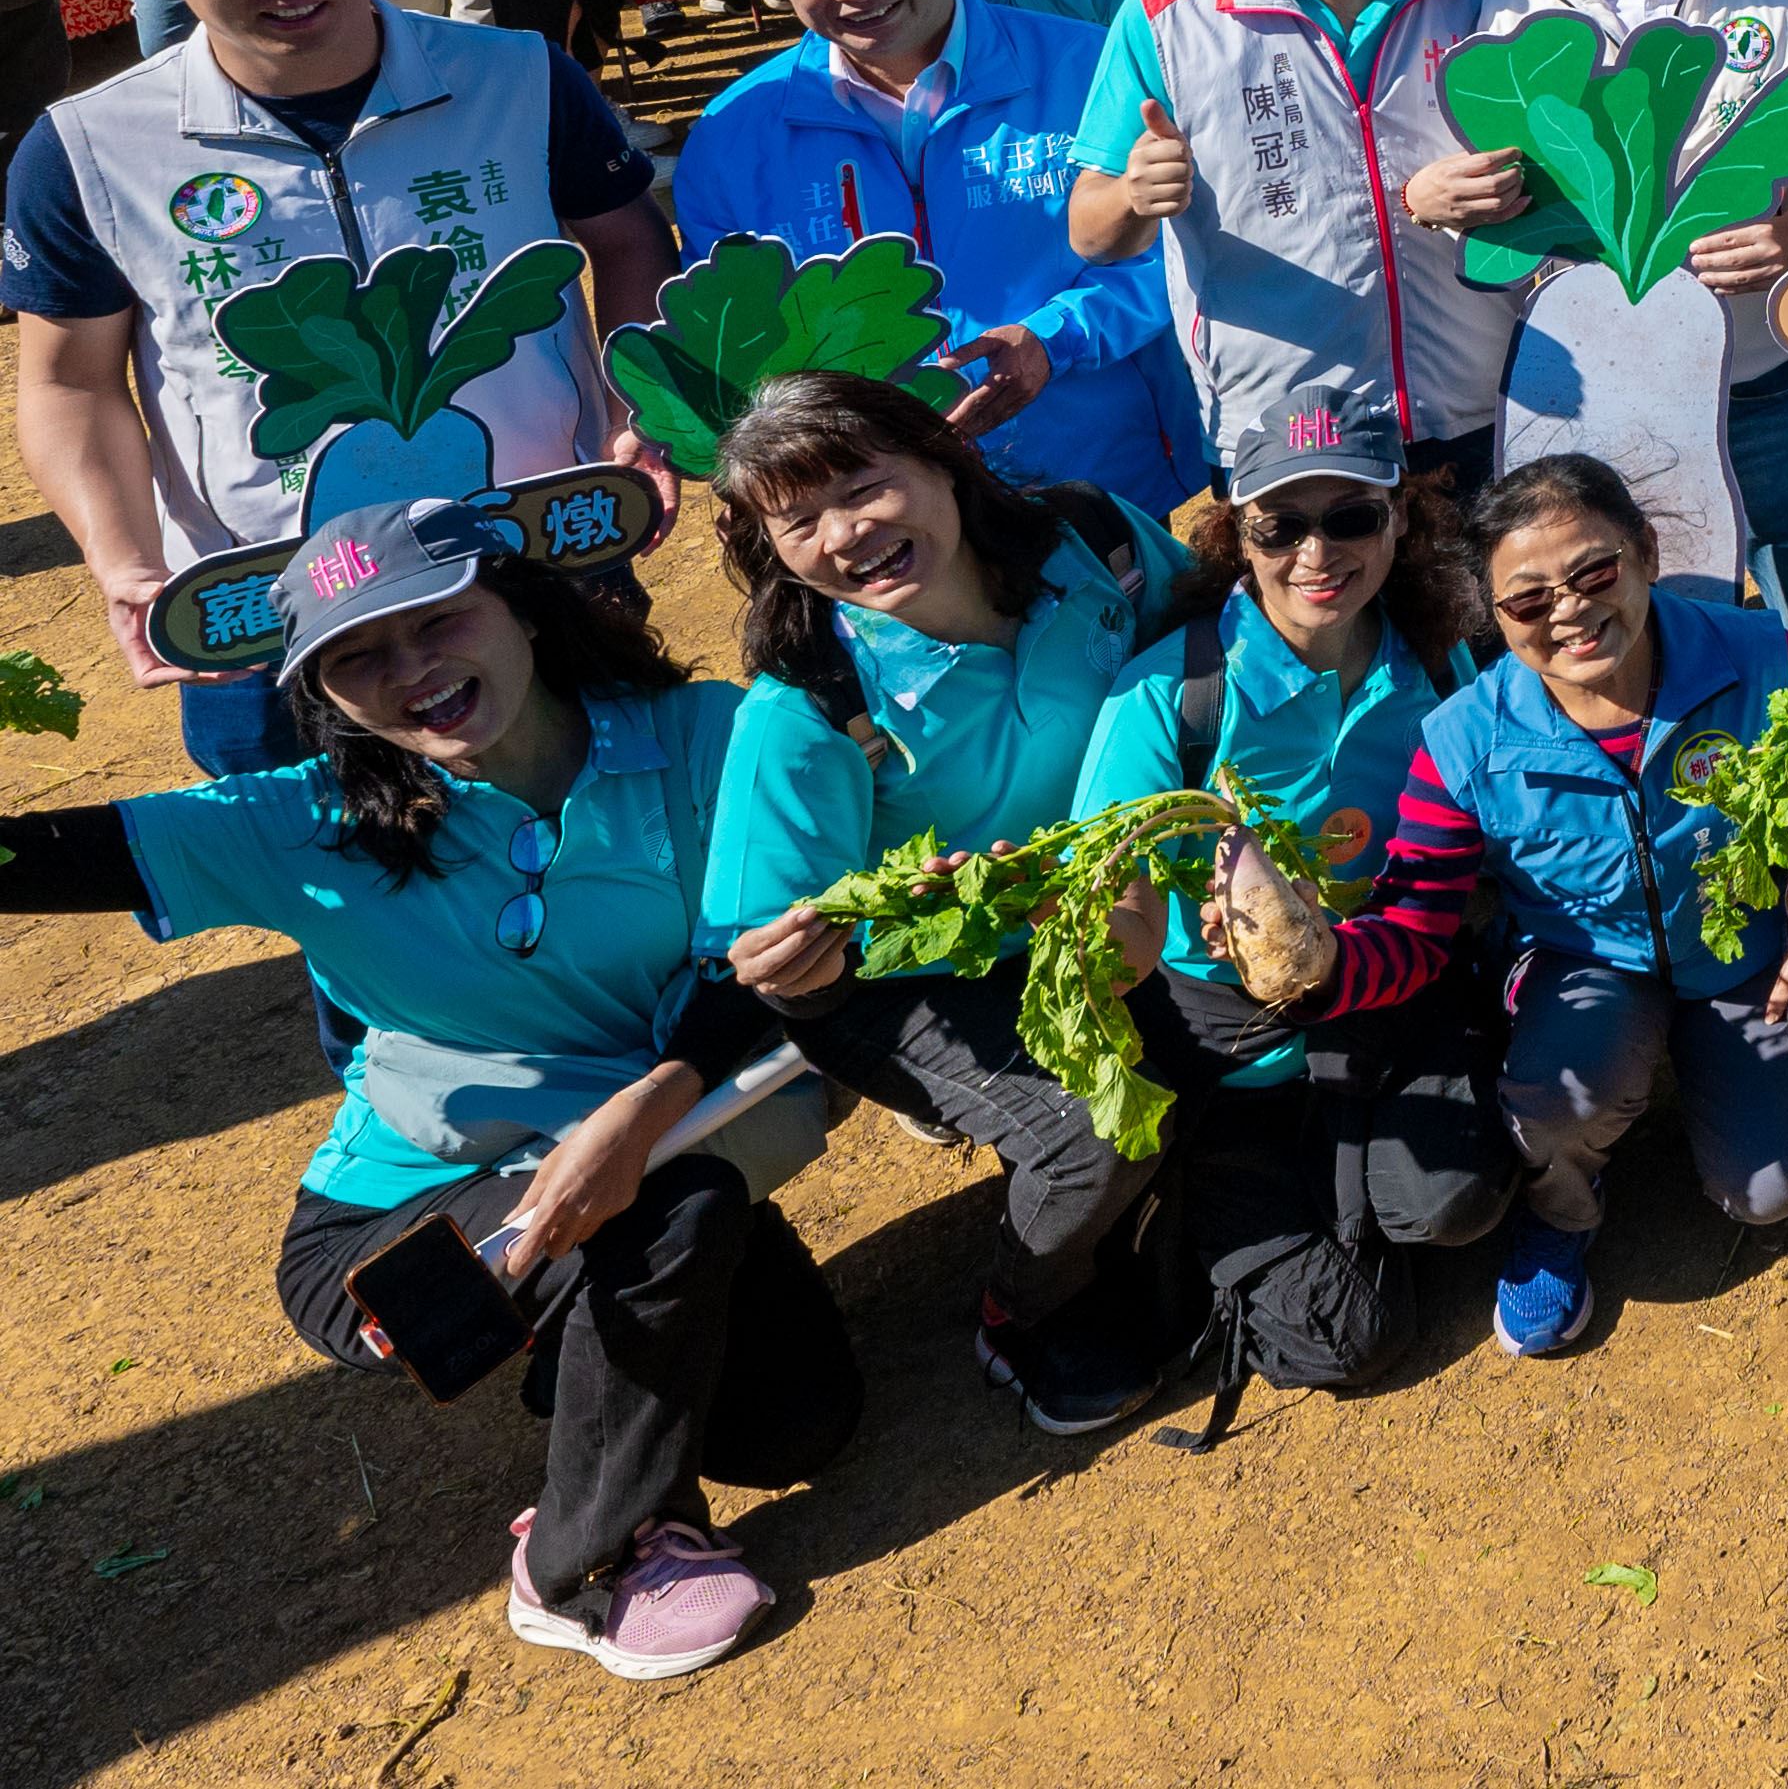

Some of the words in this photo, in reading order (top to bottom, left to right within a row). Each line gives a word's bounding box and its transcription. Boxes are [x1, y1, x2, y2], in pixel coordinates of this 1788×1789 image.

[1273, 52, 1310, 152] 農業局長
[480, 159, 509, 206] 主任
[1241, 83, 1299, 219] 陳冠義
[801, 181, 839, 246] 主任
